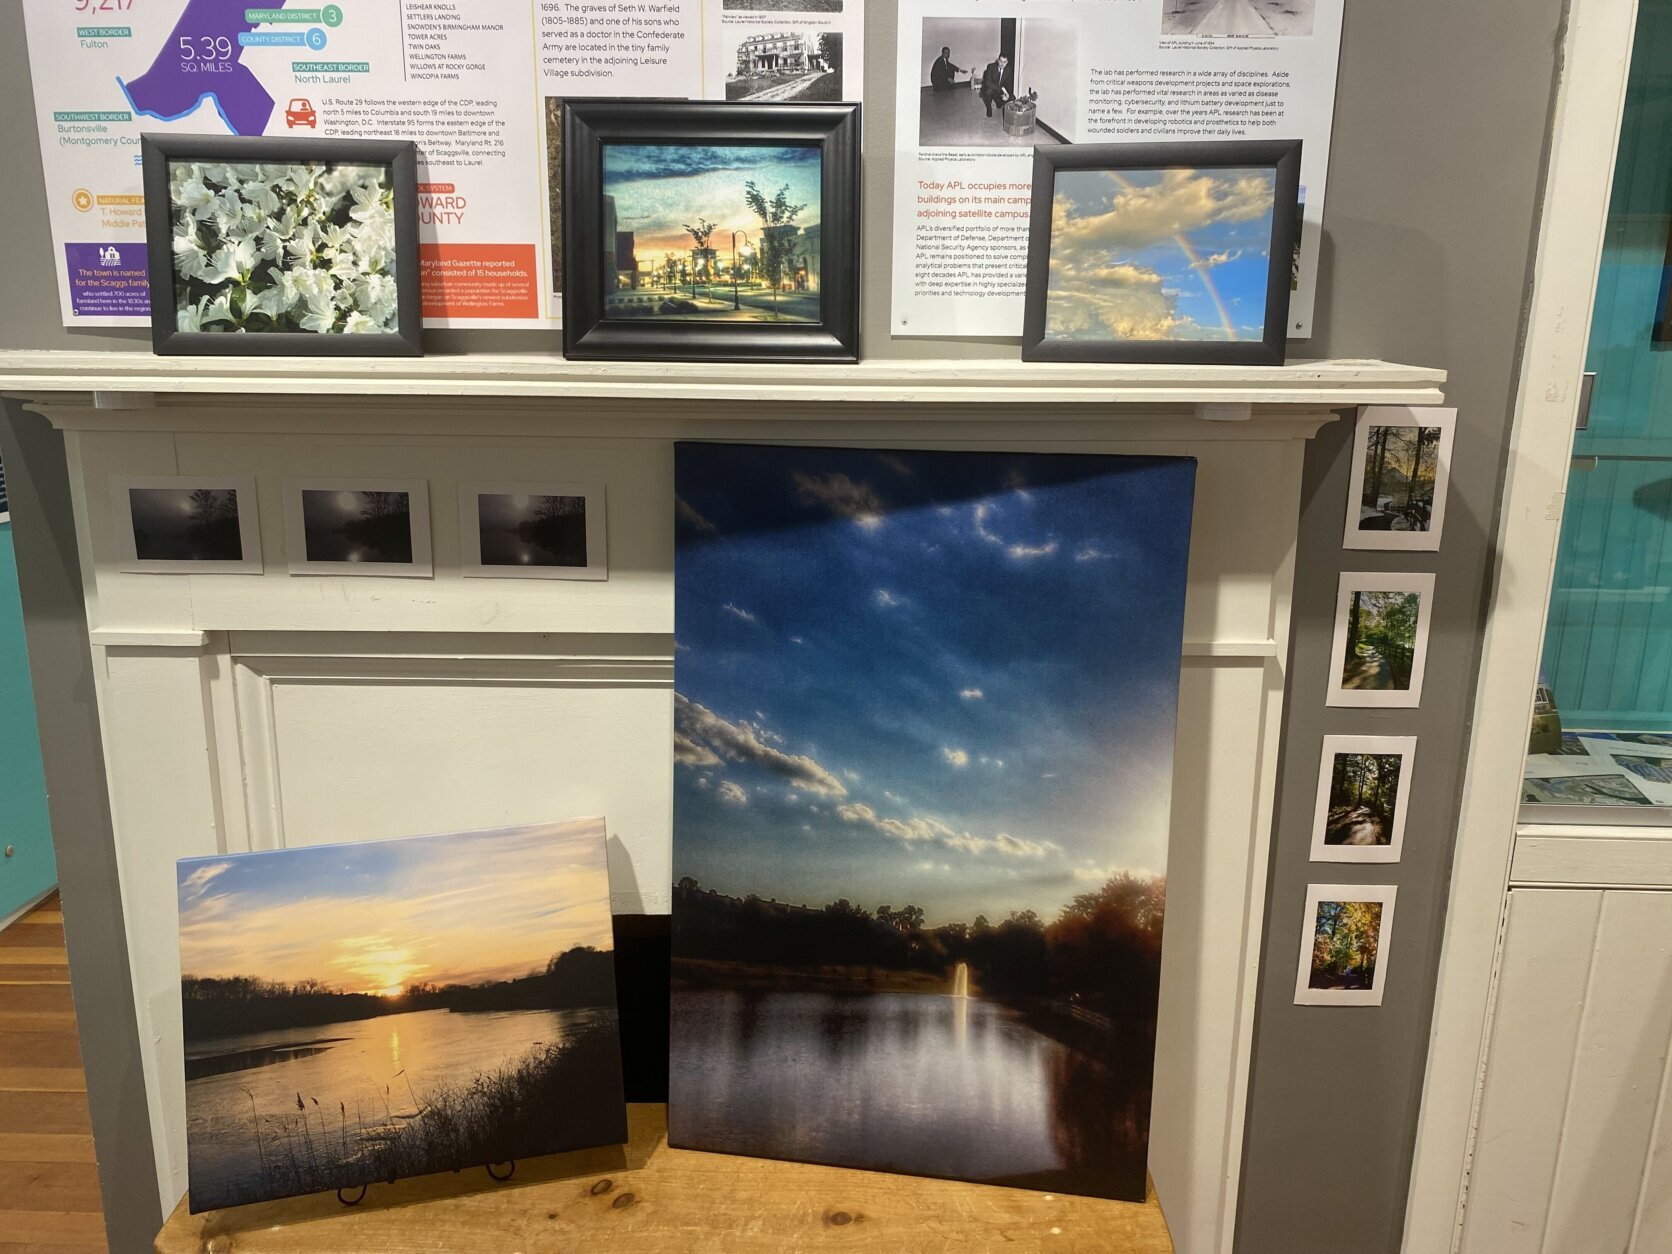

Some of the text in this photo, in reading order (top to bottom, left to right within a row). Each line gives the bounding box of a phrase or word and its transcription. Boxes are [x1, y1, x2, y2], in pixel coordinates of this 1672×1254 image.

[564, 4, 580, 12] The
[581, 6, 606, 14] graves
[608, 4, 616, 12] of
[619, 4, 636, 12] Seth
[637, 4, 646, 12] W.
[648, 4, 680, 13] Warfield
[248, 10, 337, 22] MARYLAND DISTRICT 3
[589, 17, 605, 25] and
[622, 17, 630, 25] of
[631, 17, 642, 25] his
[663, 18, 680, 26] who
[78, 28, 128, 36] WEST BORDER
[541, 30, 568, 38] served
[586, 30, 612, 38] doctor
[613, 30, 620, 38] in
[621, 30, 634, 38] the
[636, 30, 685, 39] Confederate
[312, 32, 321, 45] 6
[80, 40, 108, 48] Fulton
[180, 36, 232, 60] 5.39
[542, 43, 563, 52] Army
[578, 43, 607, 51] located
[608, 44, 616, 52] in
[616, 44, 630, 52] the
[631, 44, 646, 53] tiny
[646, 44, 670, 53] family
[543, 56, 668, 66] cemetery in the adjoining Leisure
[200, 62, 232, 72] MILES
[338, 64, 369, 72] BORDER
[543, 69, 614, 78] Village subdivision.
[1090, 68, 1102, 76] The
[1125, 69, 1158, 78] performed
[1236, 70, 1268, 78] disciplines.
[294, 74, 351, 83] North Laurel
[364, 98, 386, 106] follows
[475, 100, 498, 108] leading
[58, 124, 108, 134] Burtonsville
[1176, 128, 1201, 136] improve
[1216, 128, 1231, 136] daily
[59, 136, 118, 146] (Montgomery
[918, 180, 945, 191] Today
[946, 181, 965, 190] APL
[967, 182, 1007, 191] occupies
[418, 196, 466, 210] WARD
[917, 195, 957, 205] buildings
[971, 195, 982, 204] its
[984, 196, 1005, 204] main
[110, 208, 142, 216] Howard
[916, 210, 956, 219] adjoining
[958, 210, 992, 218] satellite
[418, 212, 464, 224] UNTY
[101, 219, 130, 228] Middle
[965, 225, 992, 234] portfolio
[482, 260, 515, 268] reported
[100, 279, 128, 288] Scaggs
